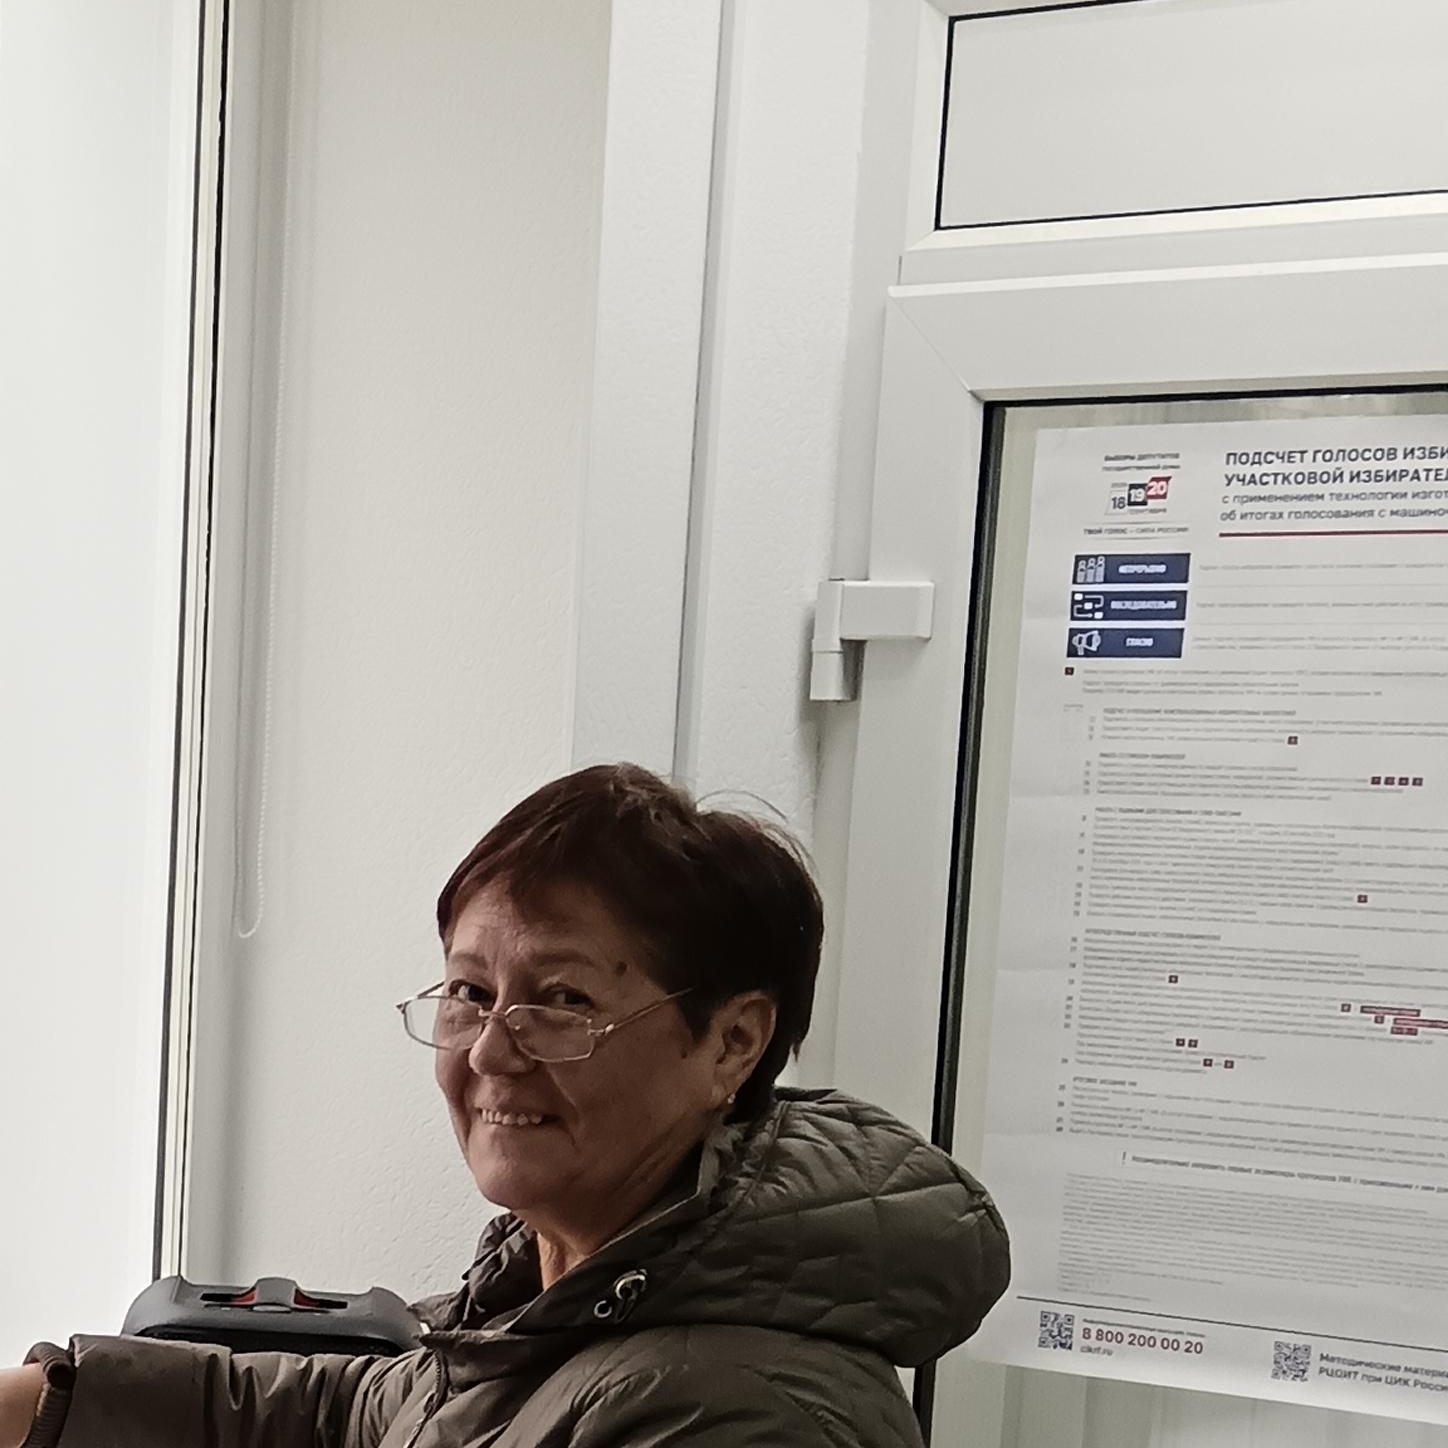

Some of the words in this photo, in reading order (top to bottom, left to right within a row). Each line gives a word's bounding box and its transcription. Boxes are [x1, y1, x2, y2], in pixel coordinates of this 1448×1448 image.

[1225, 450, 1308, 467] ПОДСЧЕТ
[1312, 447, 1399, 464] ГОЛОСОВ
[1224, 466, 1345, 487] УЧАСТКОВОЙ
[1110, 496, 1126, 510] 18
[1129, 488, 1145, 502] 19
[1147, 480, 1167, 495] 20
[1082, 1327, 1092, 1340] 8
[1095, 1328, 1124, 1344] 800
[1127, 1332, 1157, 1348] 200
[1160, 1337, 1180, 1351] 00
[1184, 1340, 1204, 1355] 20
[1384, 1375, 1412, 1387] ЦИК
